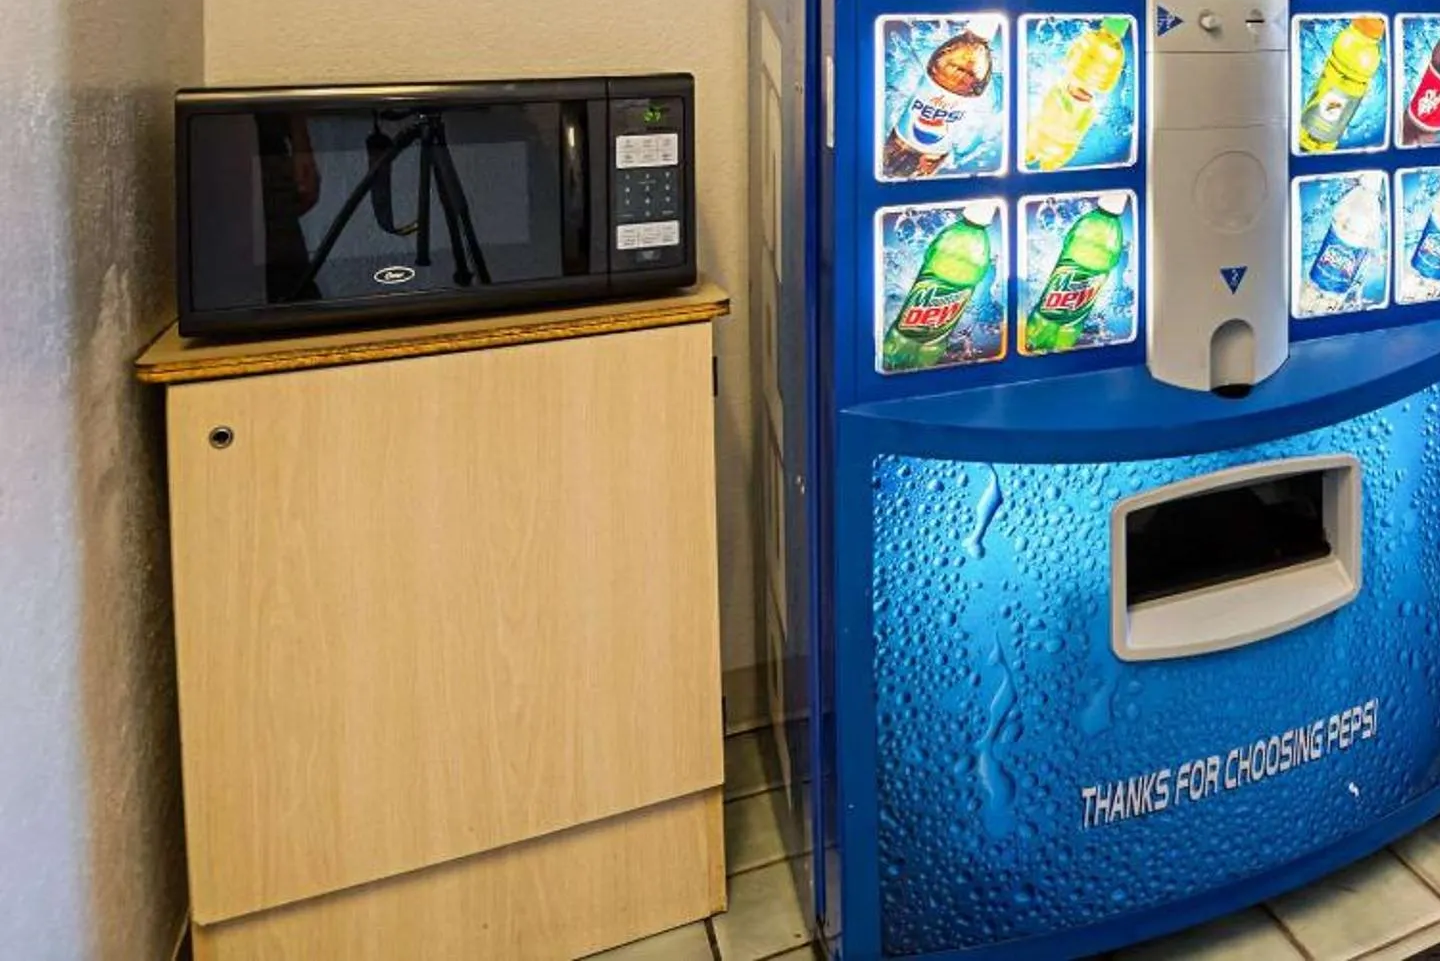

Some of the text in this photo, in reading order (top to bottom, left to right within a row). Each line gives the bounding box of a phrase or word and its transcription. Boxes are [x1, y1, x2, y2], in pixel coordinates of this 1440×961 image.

[1081, 698, 1380, 829] THANKS FOR CHOOSING PEPSI
